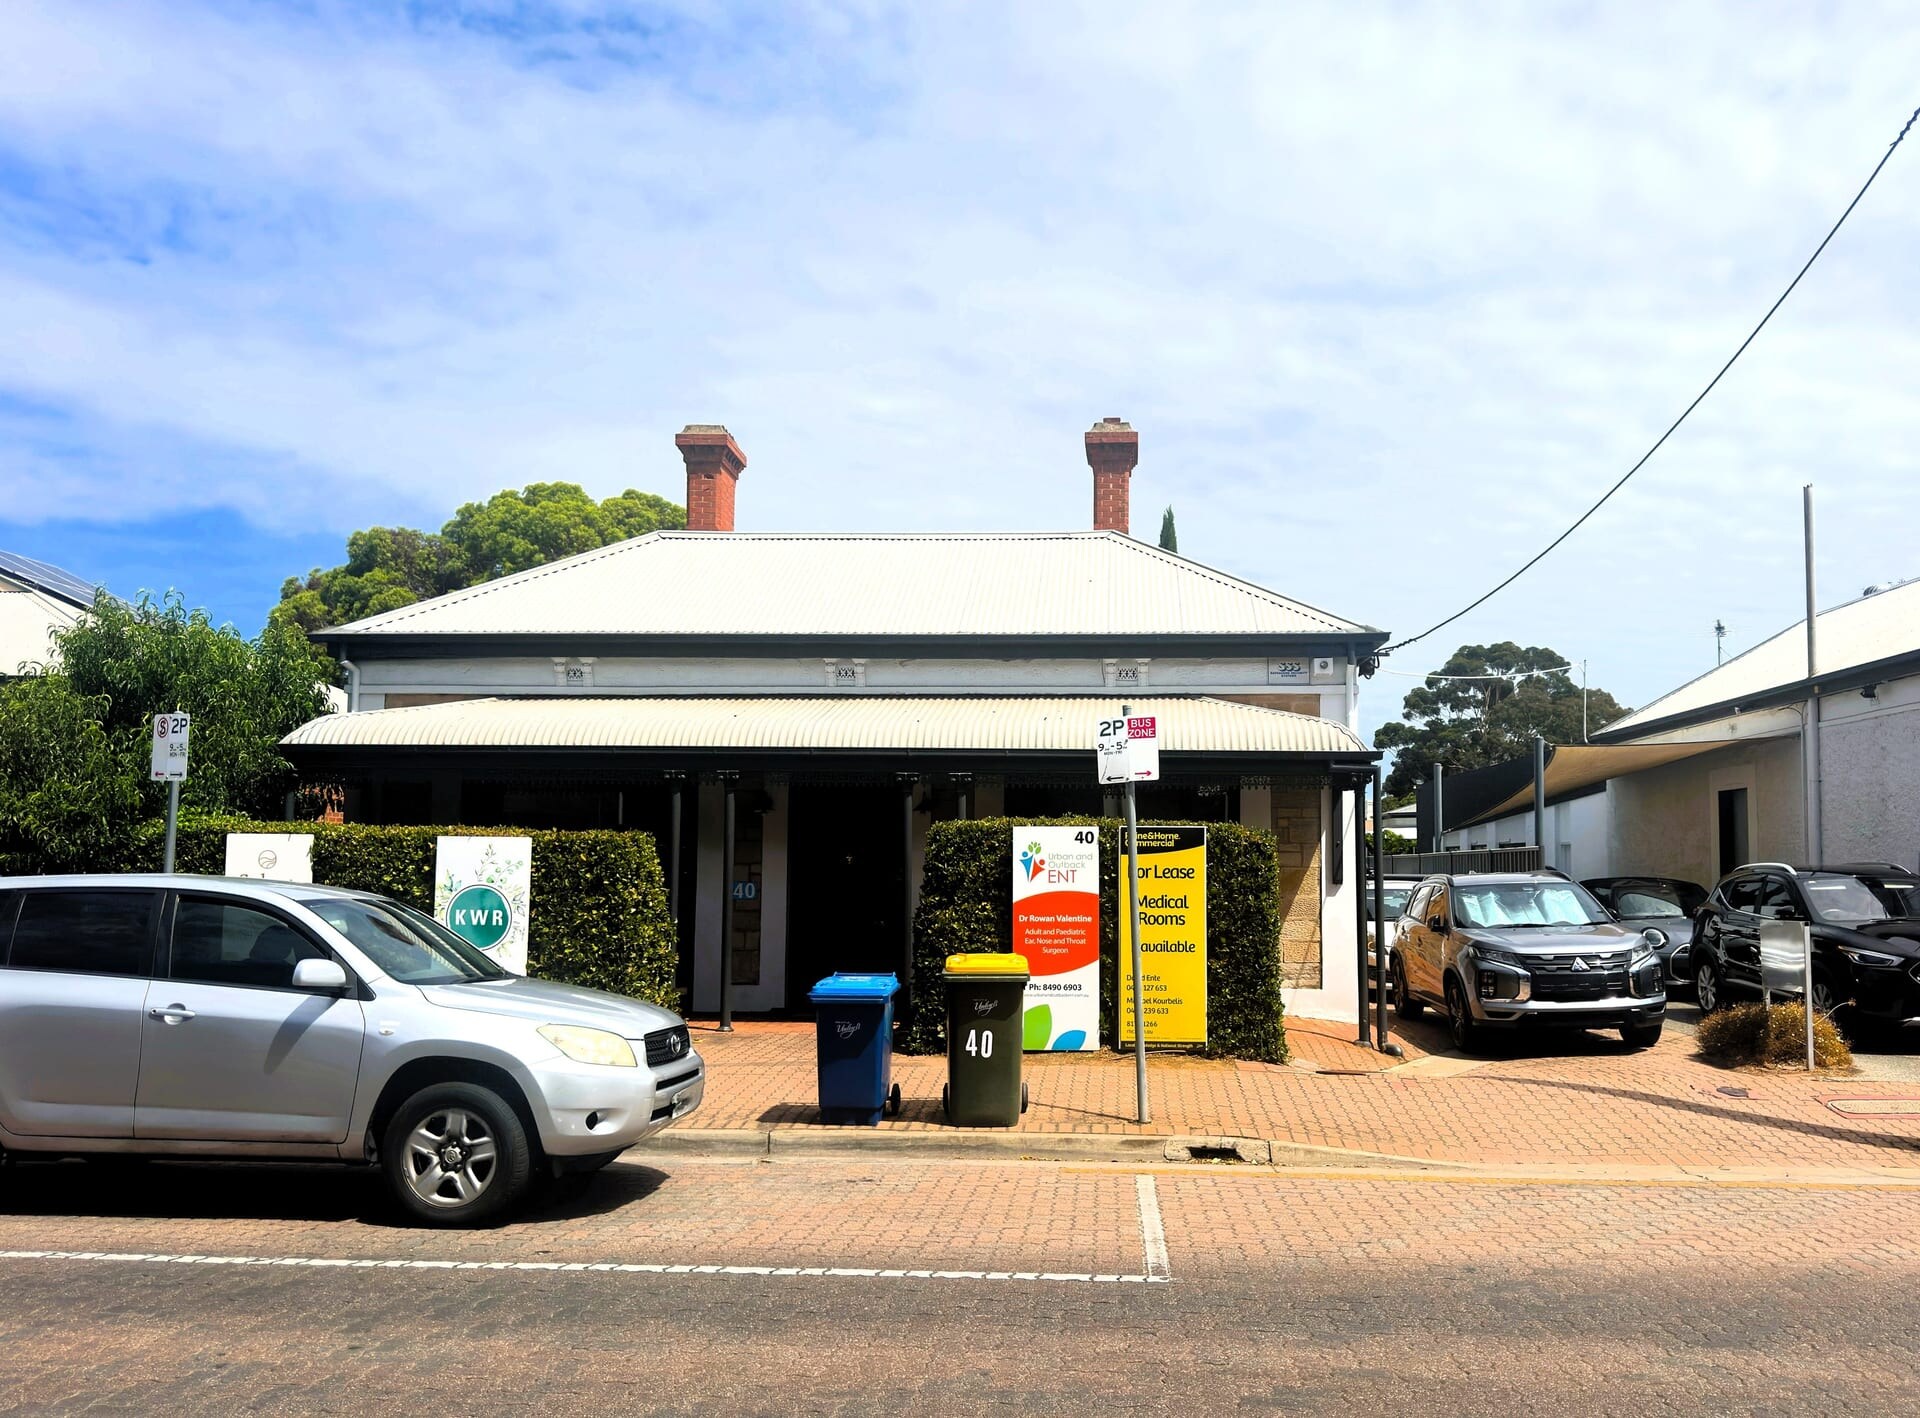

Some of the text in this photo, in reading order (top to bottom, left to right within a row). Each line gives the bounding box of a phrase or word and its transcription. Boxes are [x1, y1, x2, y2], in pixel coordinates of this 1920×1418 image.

[171, 717, 188, 734] 2P
[1099, 719, 1125, 737] 2P
[1130, 718, 1152, 728] BUS
[1127, 728, 1155, 738] ZONE
[1074, 830, 1095, 844] 40
[1048, 853, 1094, 861] Urban and
[1048, 861, 1086, 869] Outback
[1154, 864, 1196, 879] Lease
[1048, 869, 1077, 884] ENT
[733, 882, 756, 899] 40
[1018, 914, 1092, 922] Dr Rowan Valentine
[1138, 912, 1187, 926] Rooms
[1042, 946, 1069, 955] Surgeon
[1140, 940, 1196, 953] available
[1029, 983, 1082, 991] Ph: 8490 6903
[965, 1028, 993, 1059] 40
